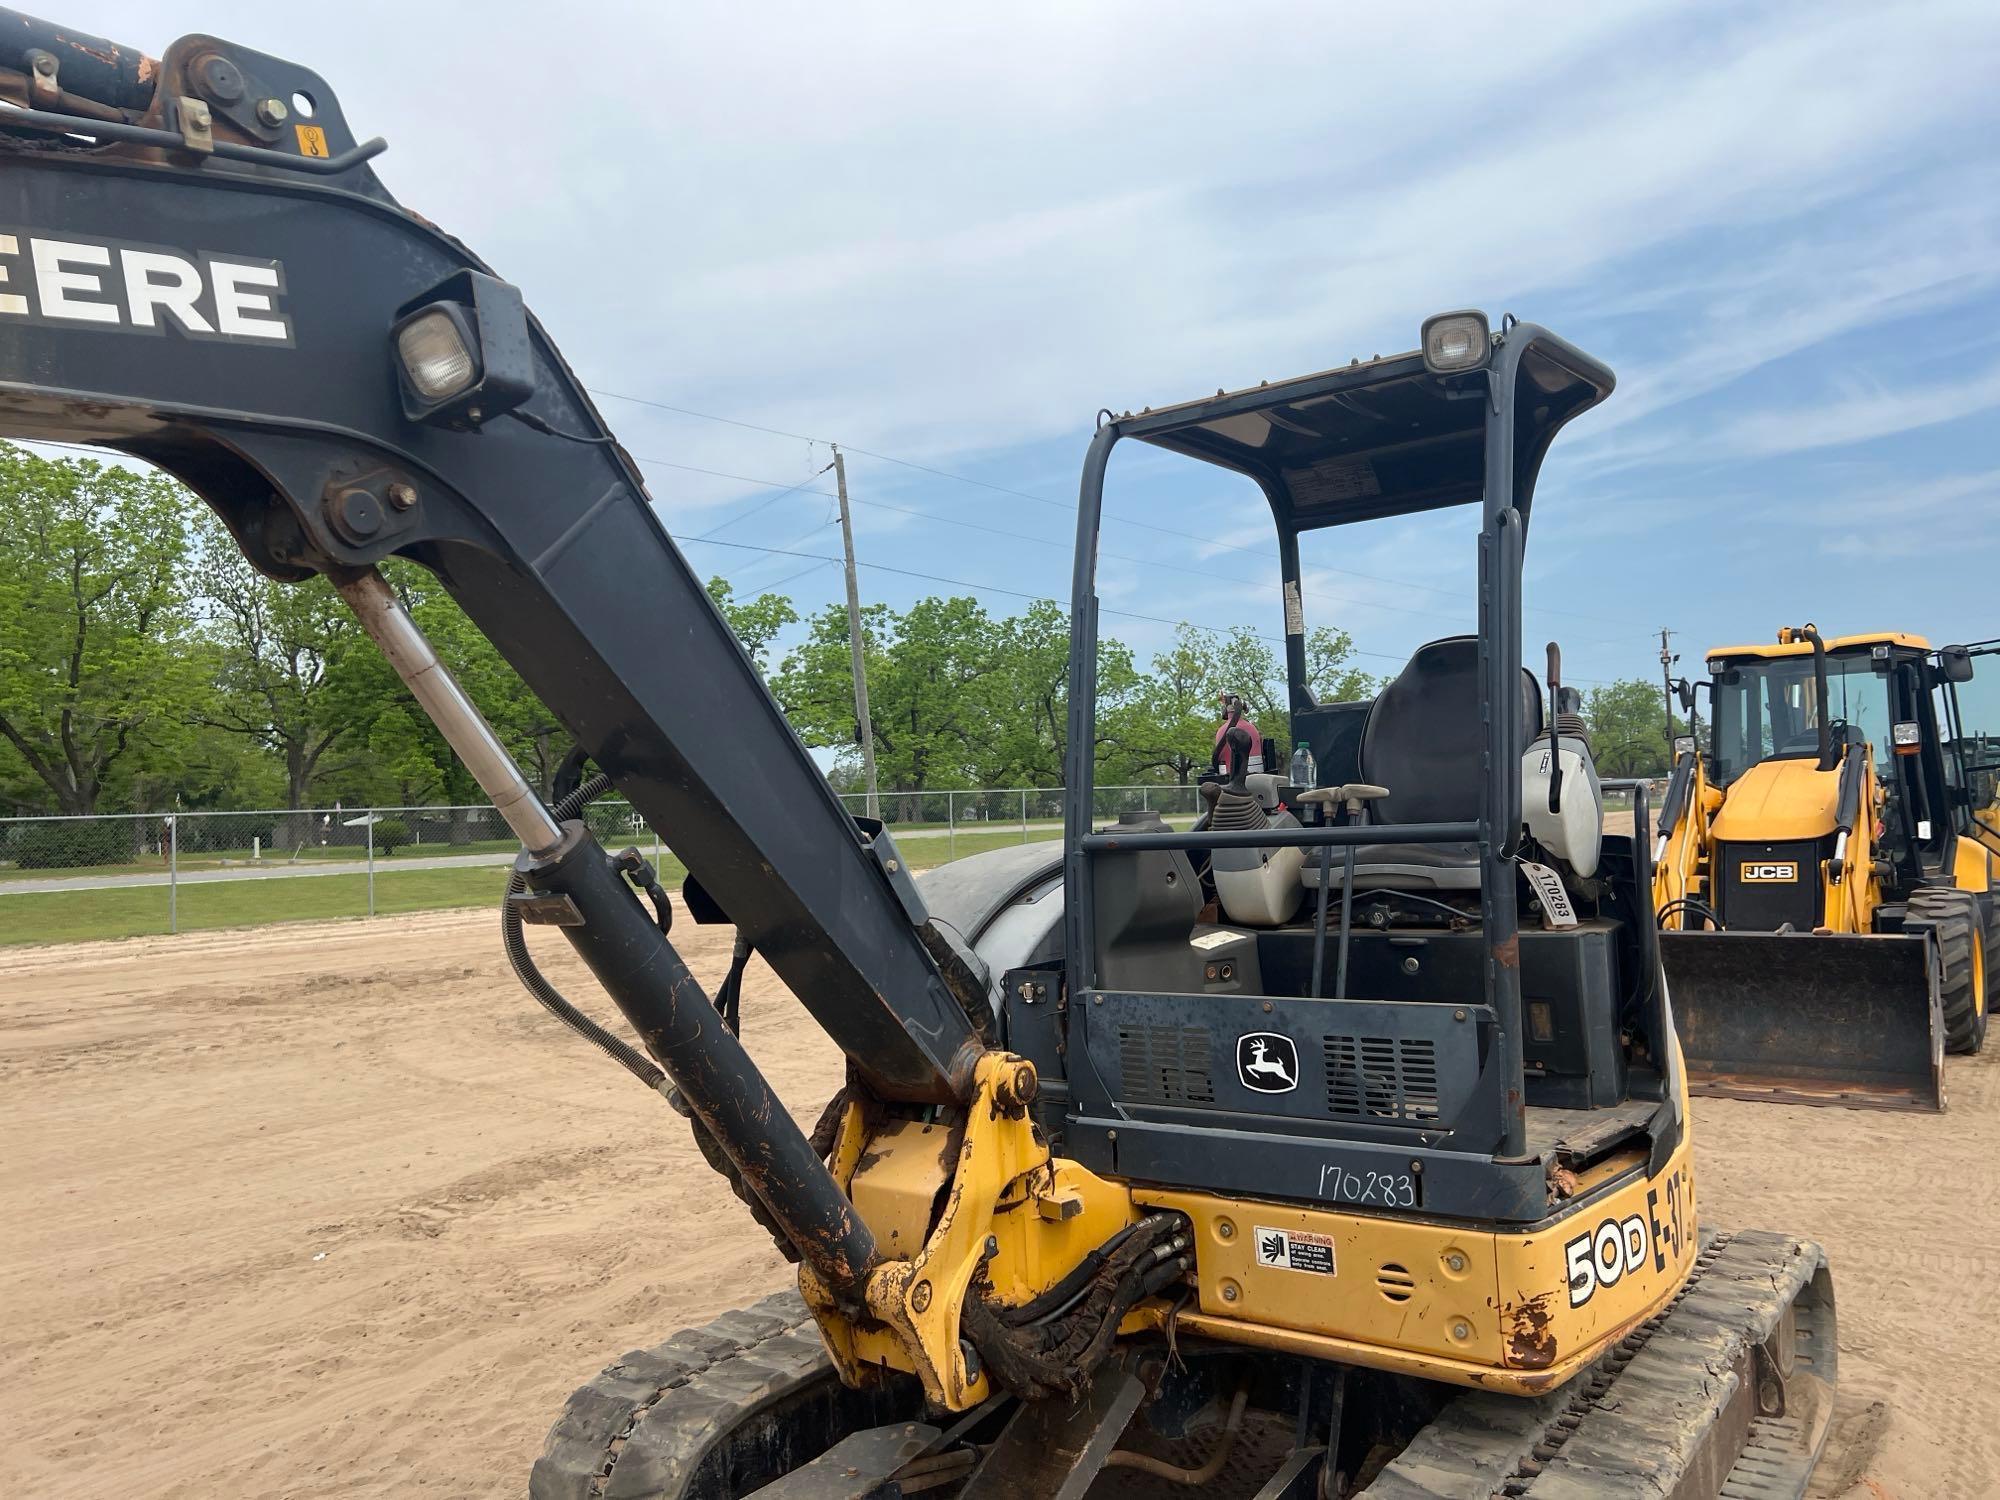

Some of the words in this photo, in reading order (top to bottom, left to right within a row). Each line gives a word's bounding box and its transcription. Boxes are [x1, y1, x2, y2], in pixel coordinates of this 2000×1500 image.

[1745, 866, 1793, 879] JCB
[1540, 873, 1570, 918] 170283
[1319, 1164, 1414, 1207] 170283
[1290, 1243, 1305, 1251] STAY
[1307, 1245, 1326, 1253] CLEAR
[1297, 1234, 1332, 1246] WARNING
[1565, 1213, 1648, 1309] 50D
